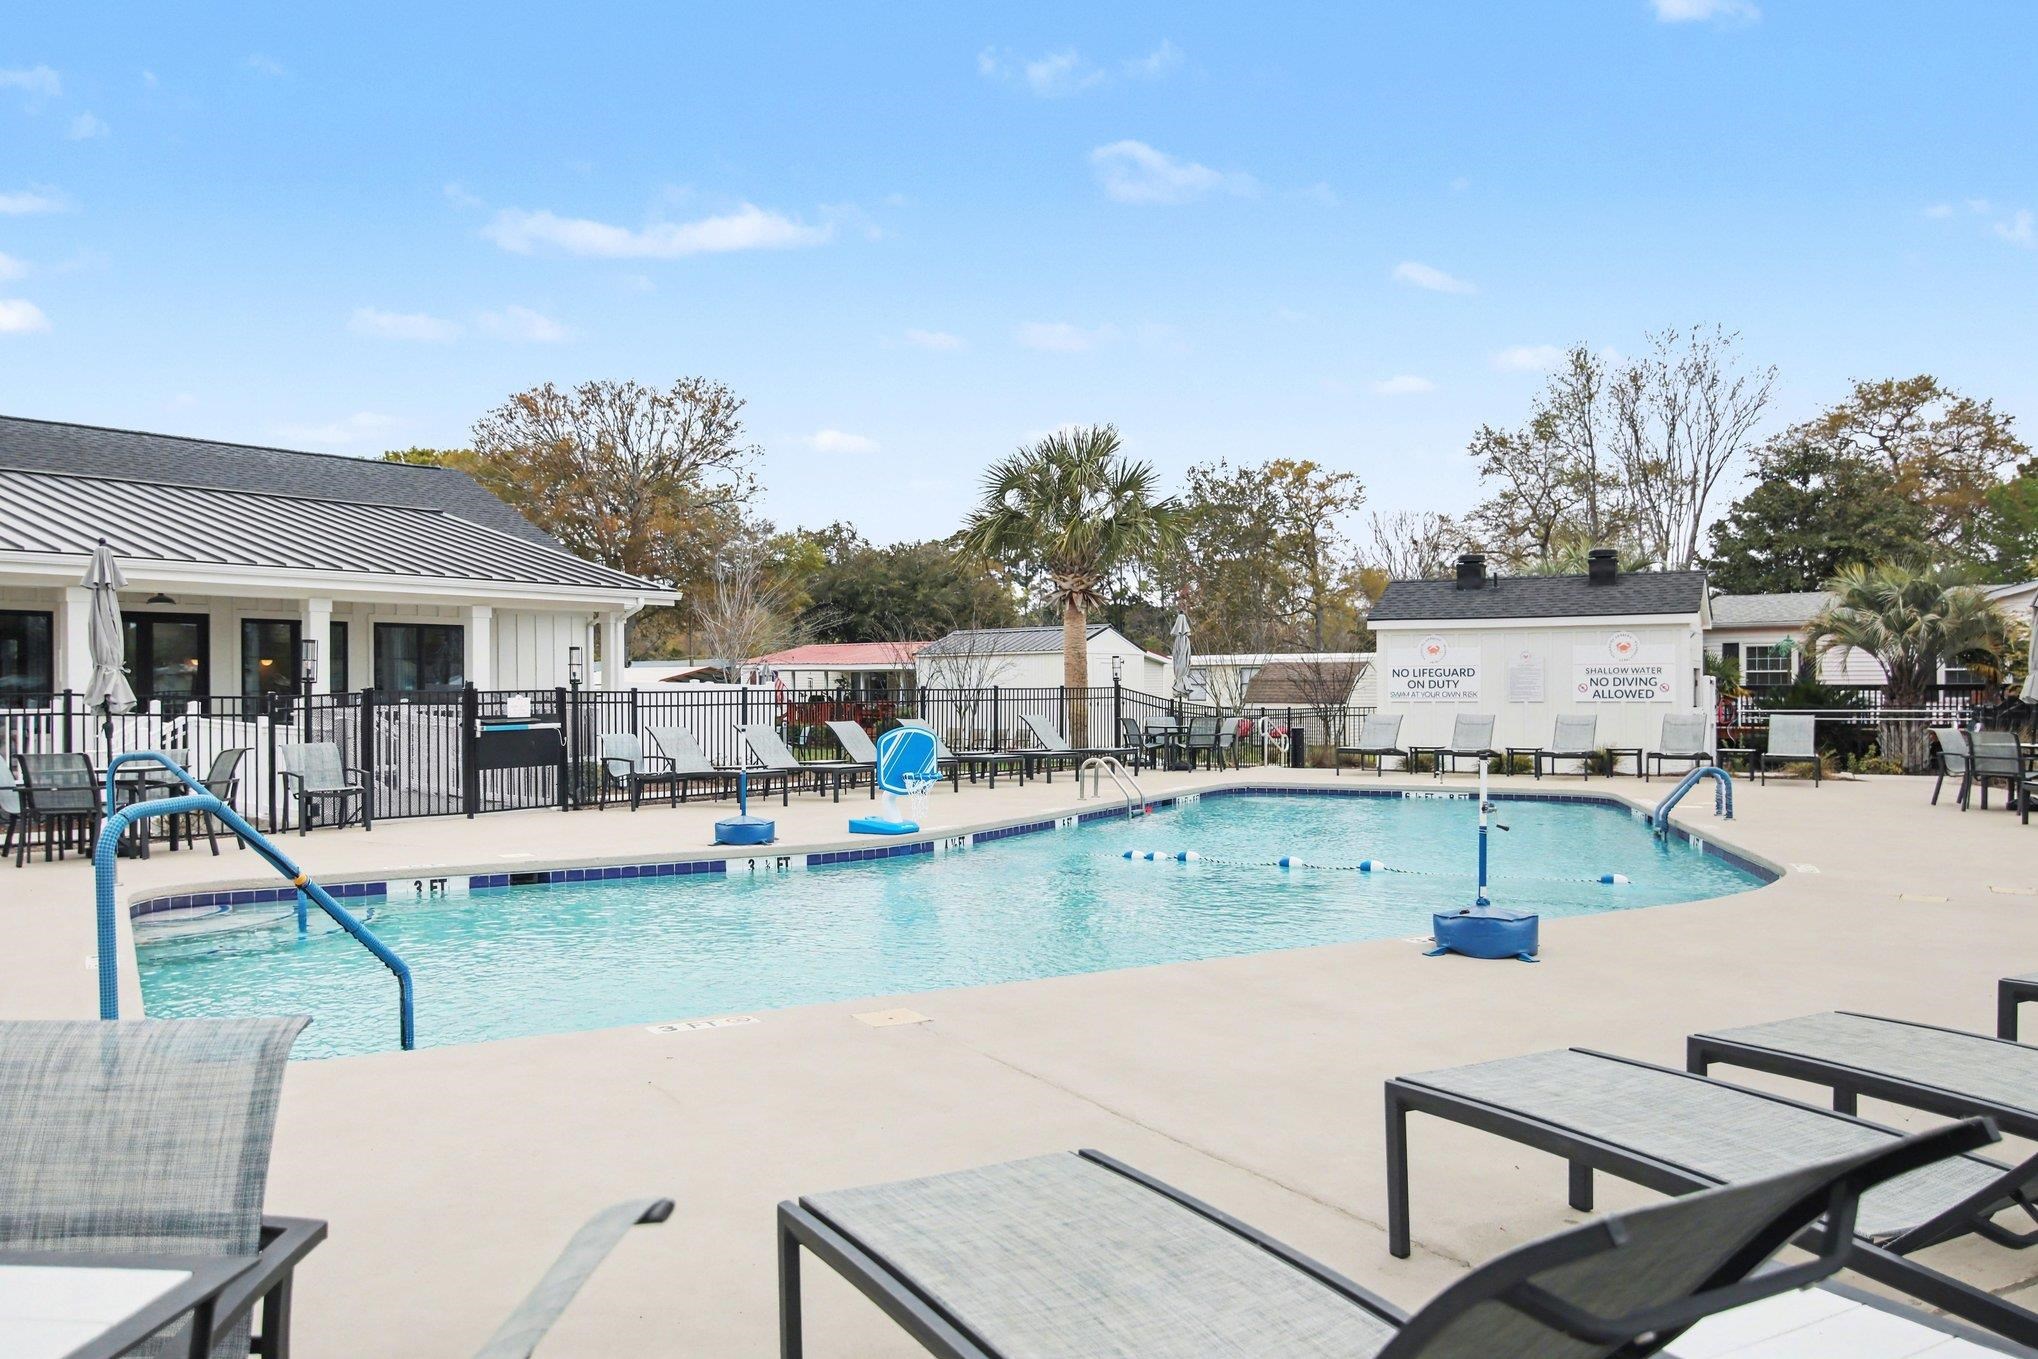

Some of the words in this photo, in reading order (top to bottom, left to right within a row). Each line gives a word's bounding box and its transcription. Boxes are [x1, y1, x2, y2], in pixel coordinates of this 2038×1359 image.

[1392, 668, 1409, 678] NO
[1413, 668, 1476, 677] LIFEGUARD
[1407, 680, 1425, 689] ON
[1428, 680, 1460, 688] DUTY
[1590, 677, 1609, 687] NO
[1613, 677, 1658, 687] DIVING
[1592, 689, 1655, 699] ALLOWED
[748, 859, 755, 870] 3
[777, 857, 791, 870] FT
[414, 880, 423, 892] 3
[430, 879, 447, 892] FT
